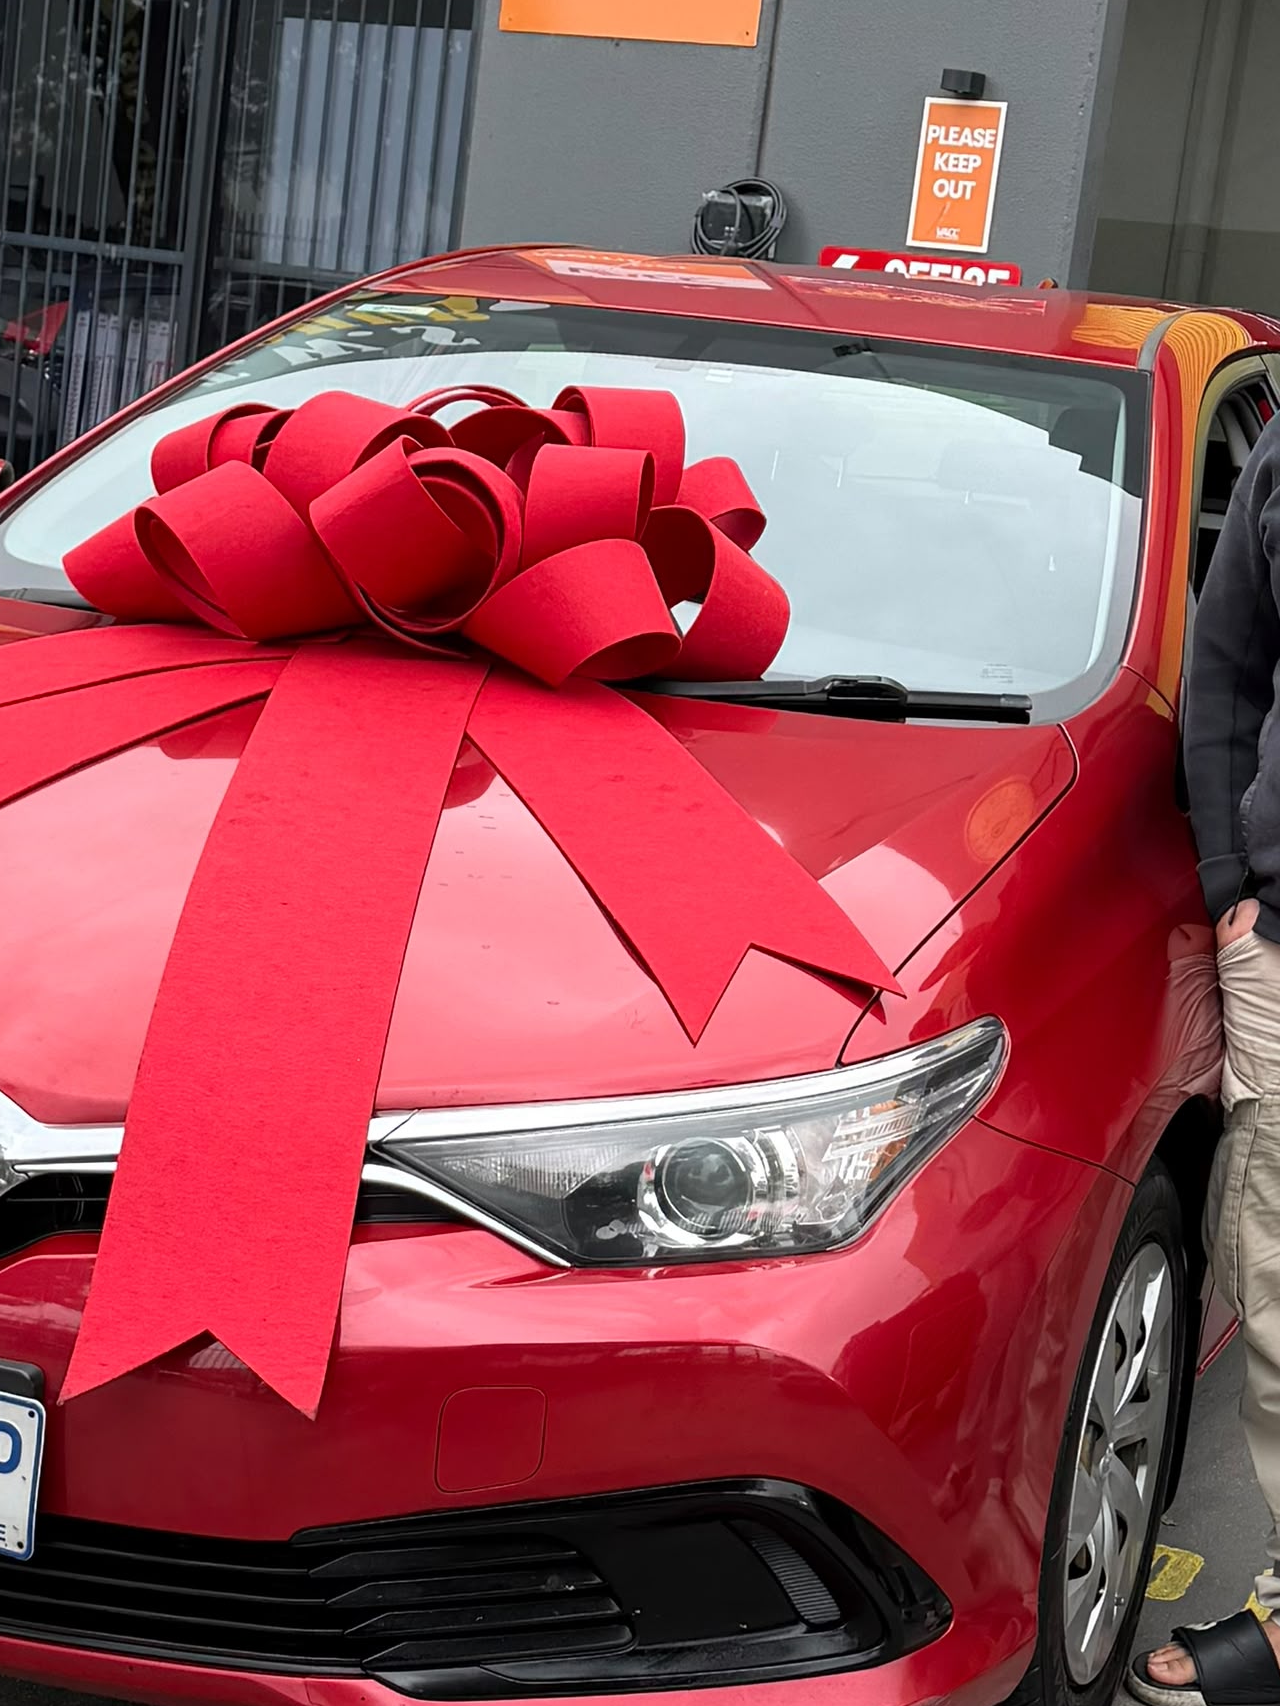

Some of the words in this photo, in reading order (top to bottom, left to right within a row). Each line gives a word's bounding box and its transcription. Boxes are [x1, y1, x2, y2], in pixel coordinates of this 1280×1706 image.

[927, 124, 997, 149] PLEASE
[933, 152, 982, 173] KEEP
[933, 179, 976, 200] OUT
